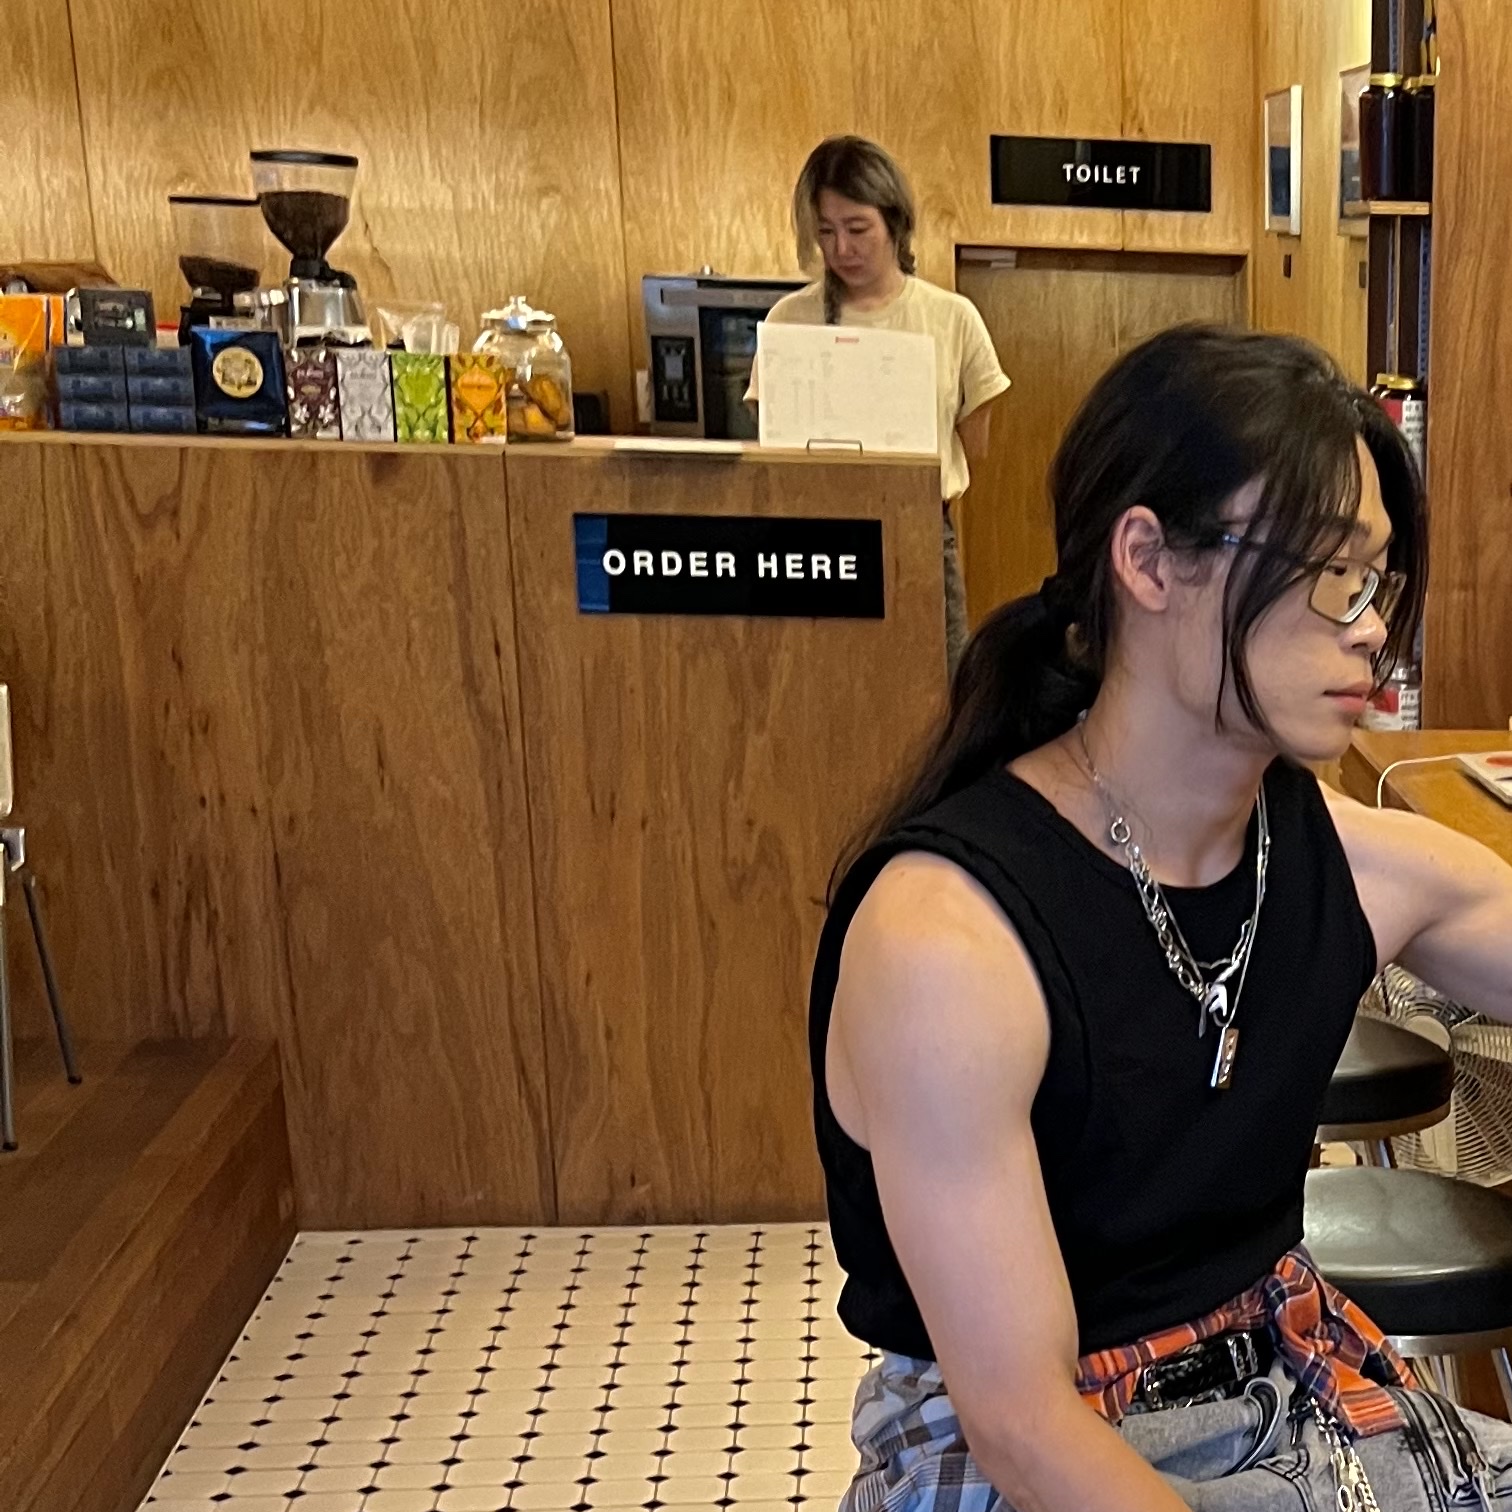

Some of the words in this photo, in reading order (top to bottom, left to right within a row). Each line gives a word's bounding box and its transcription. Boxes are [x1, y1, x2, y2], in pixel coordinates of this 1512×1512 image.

[1062, 163, 1141, 185] TOILET
[602, 549, 736, 578] ORDER
[757, 551, 858, 580] HERE
